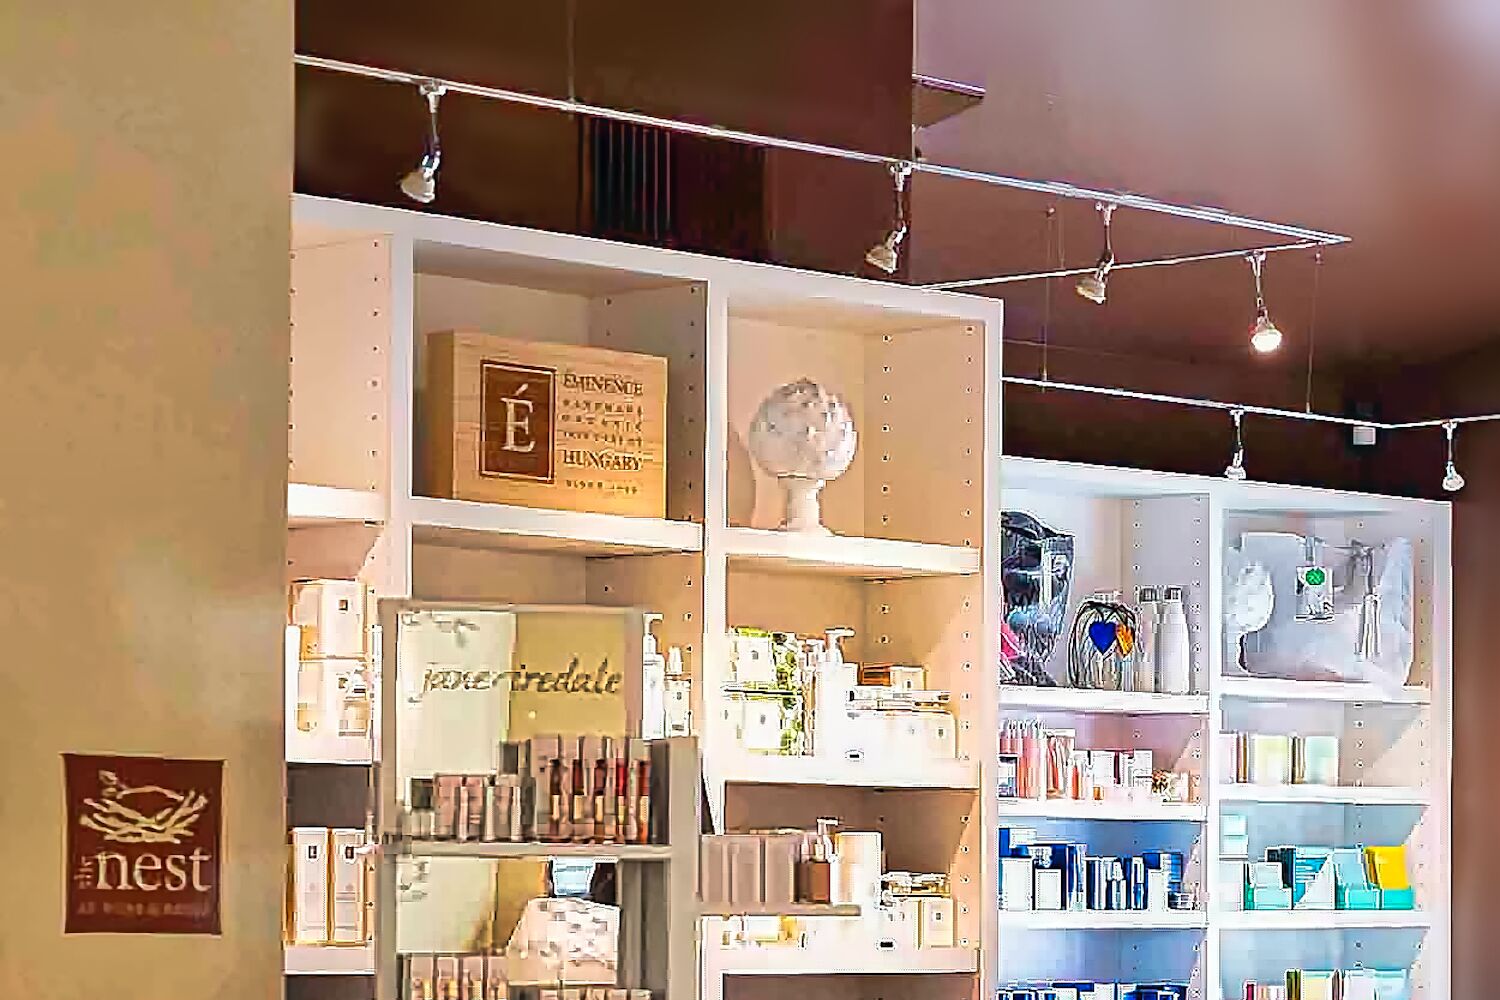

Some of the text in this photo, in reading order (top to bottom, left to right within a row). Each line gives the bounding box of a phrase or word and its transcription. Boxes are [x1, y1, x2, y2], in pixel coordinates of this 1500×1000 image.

[500, 383, 536, 452] É
[564, 449, 642, 471] HUNGARY
[95, 847, 213, 892] nest
